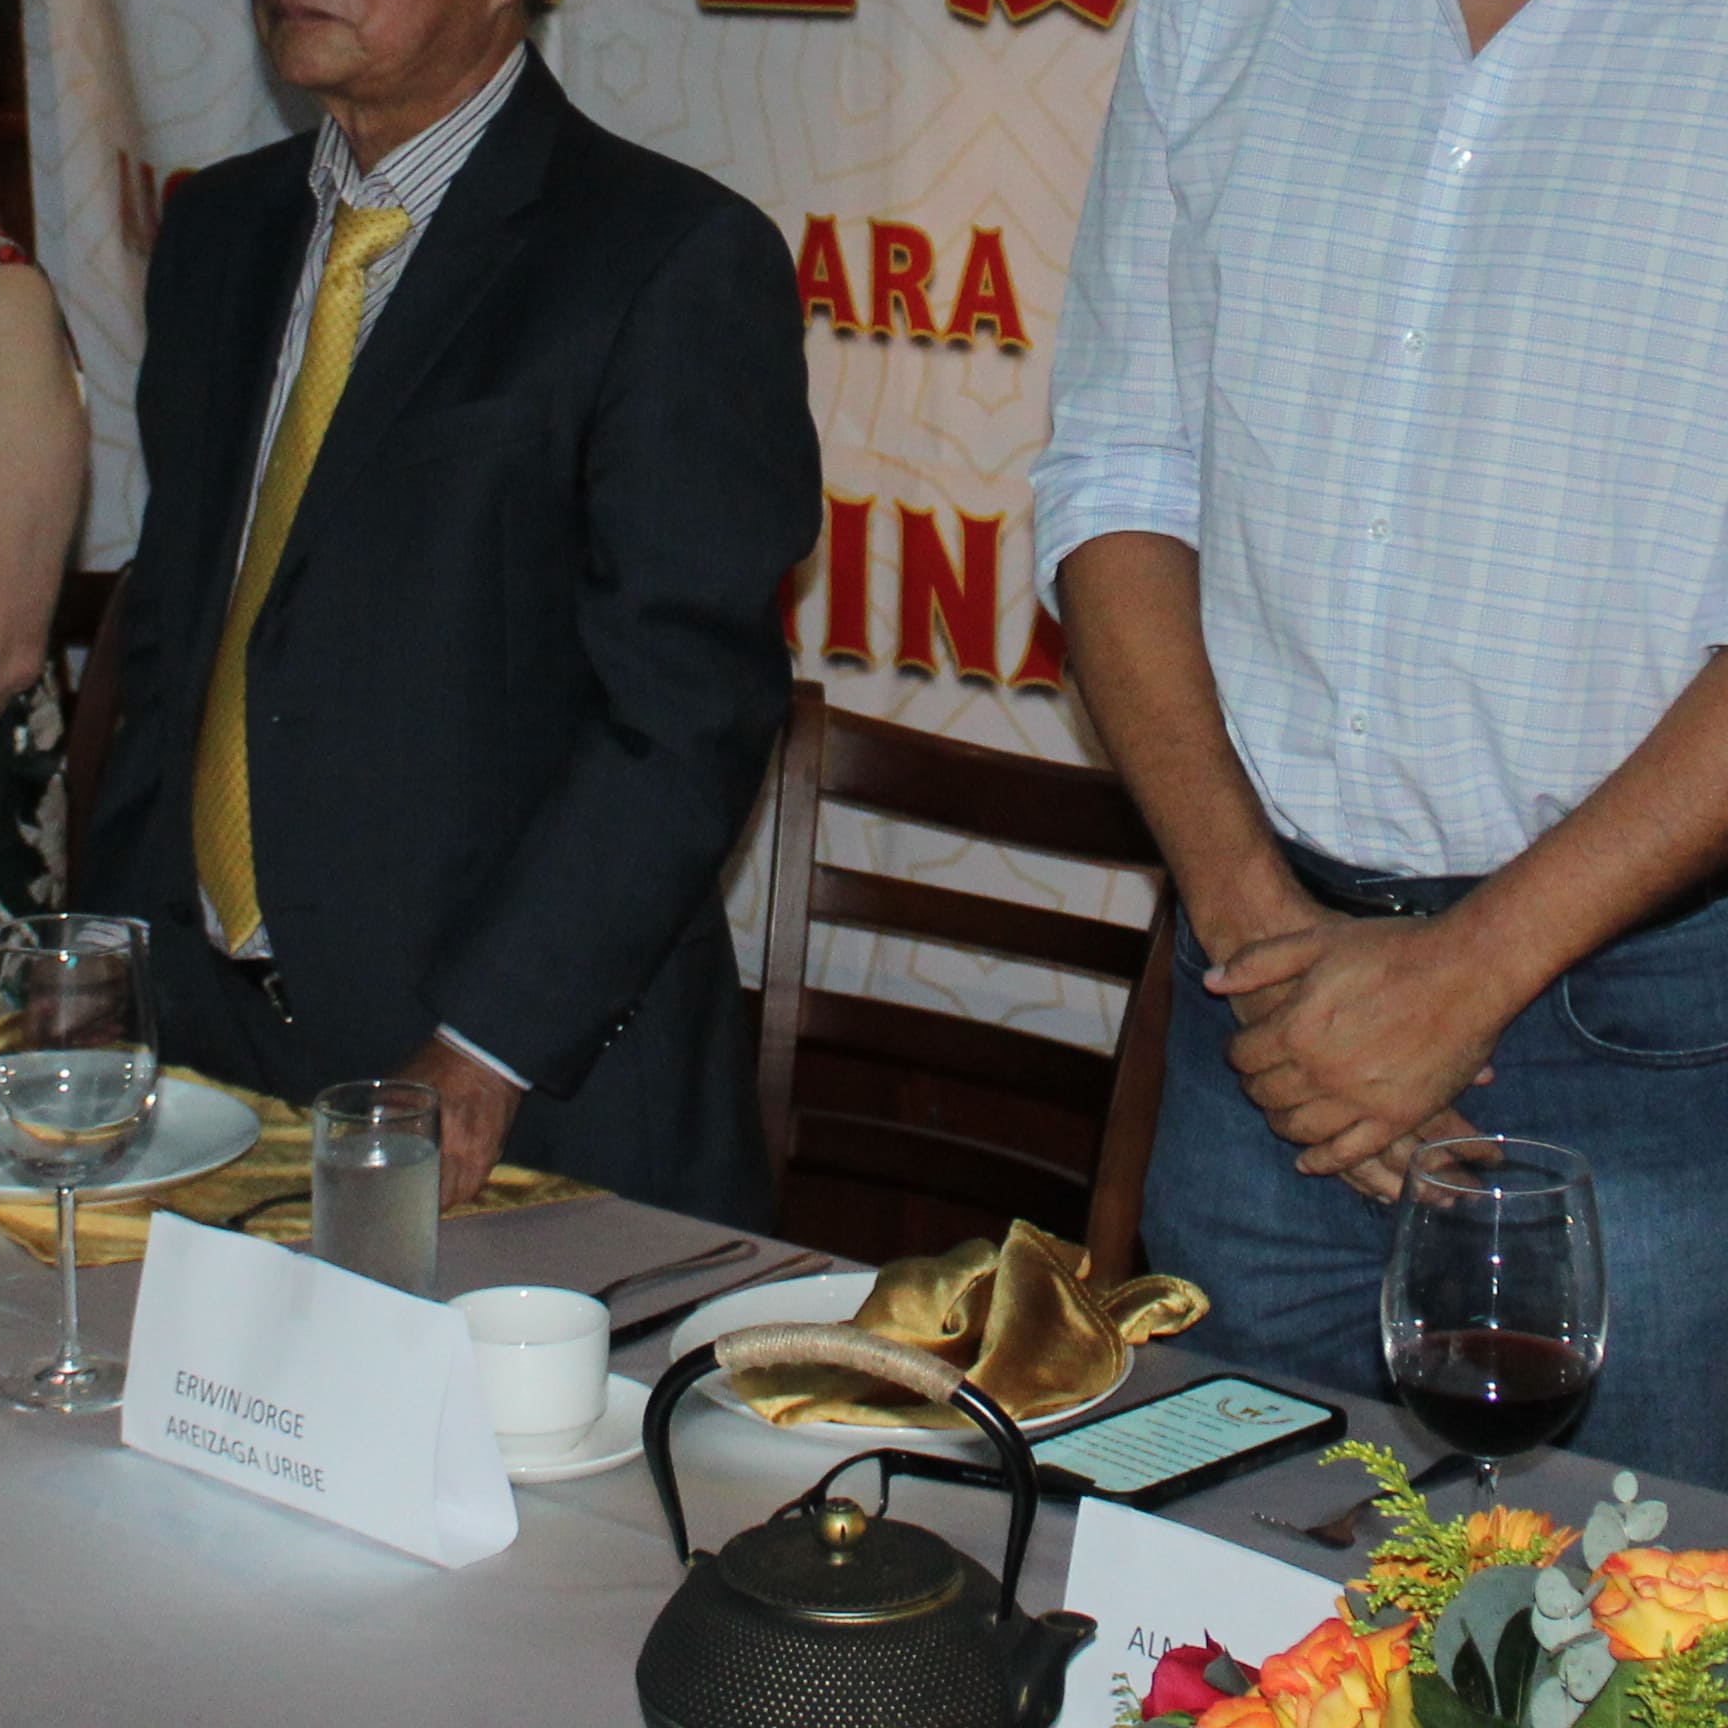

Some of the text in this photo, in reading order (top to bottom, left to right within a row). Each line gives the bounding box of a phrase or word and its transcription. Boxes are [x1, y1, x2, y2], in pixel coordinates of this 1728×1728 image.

[779, 493, 1067, 692] IN
[174, 1369, 306, 1440] ERWIN JORGE
[165, 1414, 327, 1493] AREIZAGA URIBE
